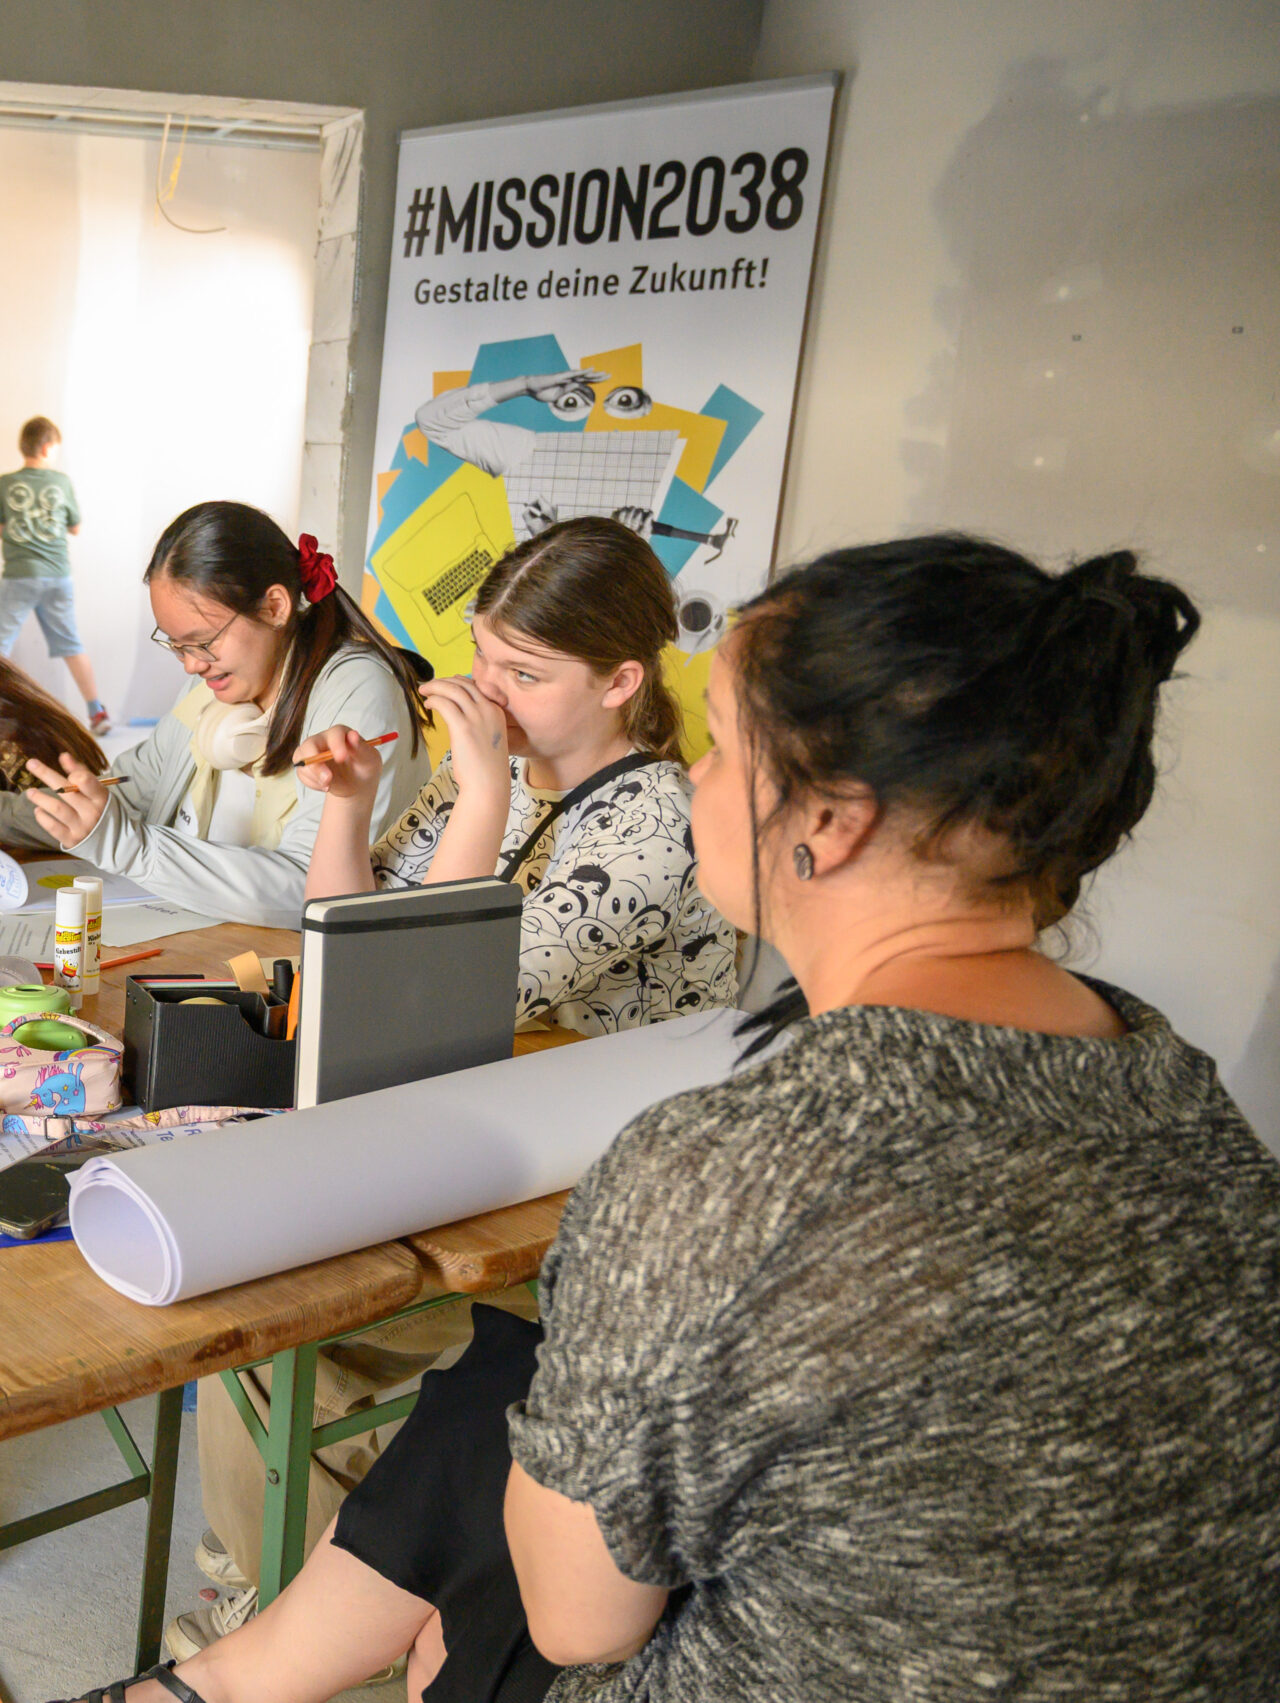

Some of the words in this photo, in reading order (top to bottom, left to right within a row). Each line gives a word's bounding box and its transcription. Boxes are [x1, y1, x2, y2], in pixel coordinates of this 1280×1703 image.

[402, 147, 809, 258] #MISSION2038
[414, 272, 528, 305] Gestalte
[537, 267, 620, 299] deine
[629, 257, 770, 296] Zukunft!
